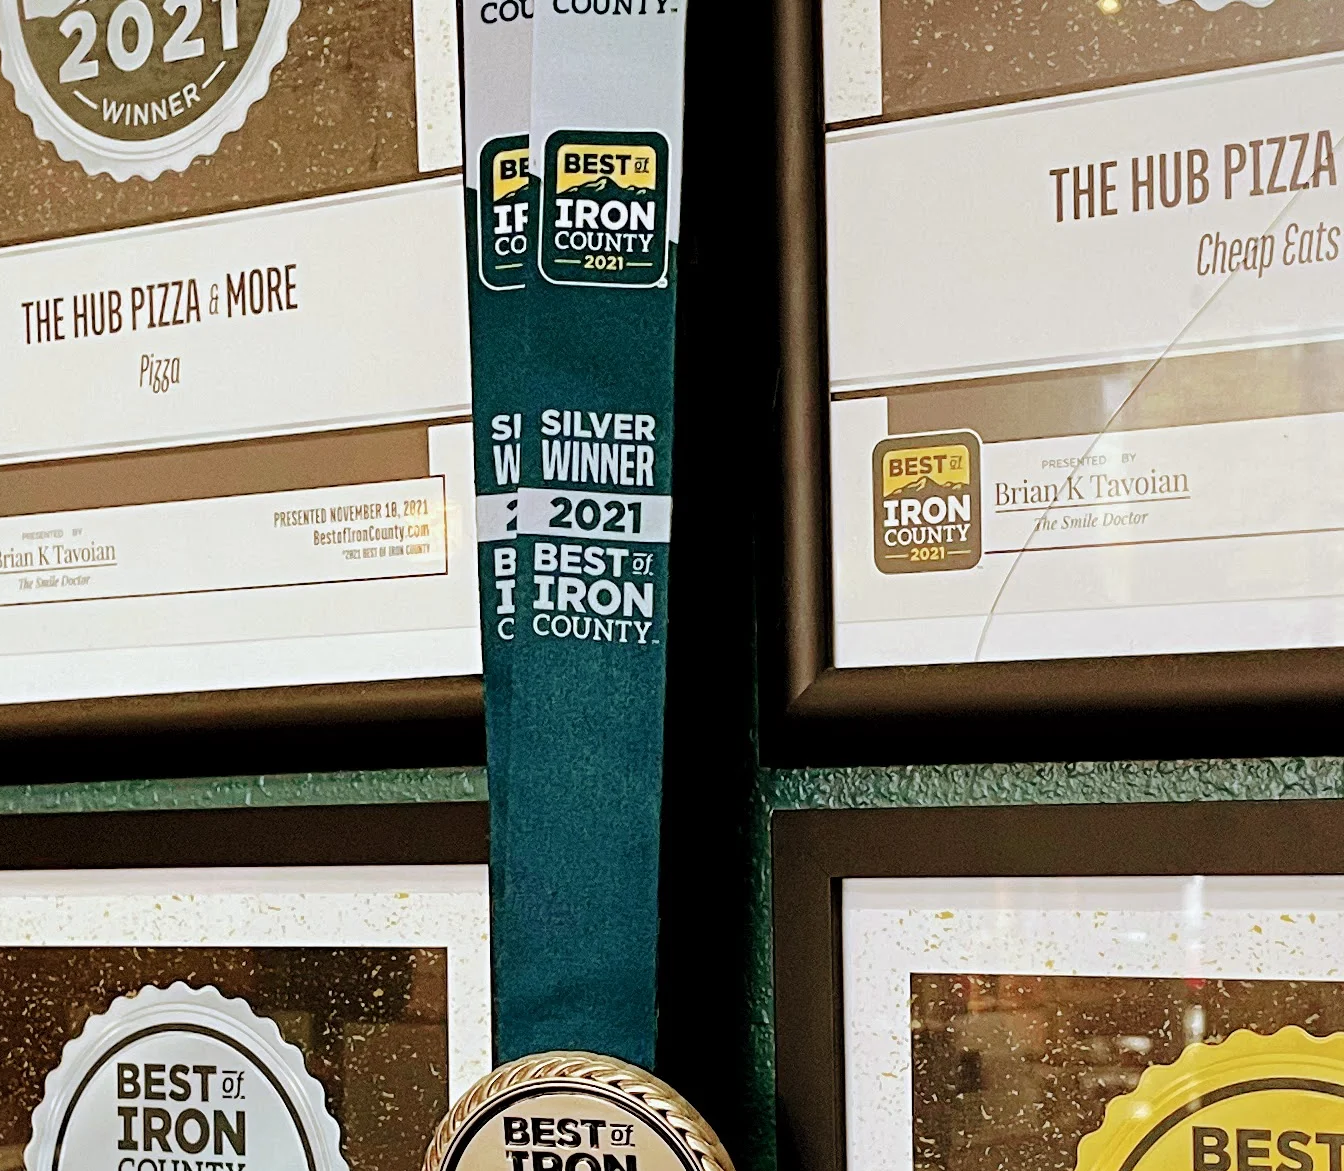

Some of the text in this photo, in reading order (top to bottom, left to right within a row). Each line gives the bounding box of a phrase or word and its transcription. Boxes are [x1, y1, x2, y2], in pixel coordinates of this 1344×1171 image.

[102, 84, 201, 127] WINNER
[1050, 161, 1117, 222] THE
[1132, 149, 1209, 210] HUB
[1225, 130, 1337, 199] PIZZA
[555, 231, 653, 252] COUNTY
[1196, 223, 1341, 278] Cheap Eats
[584, 255, 624, 270] 2021
[21, 297, 66, 345] THE
[72, 289, 123, 338] HUB
[130, 279, 201, 331] PIZZA
[226, 264, 298, 318] MORE
[541, 409, 655, 441] SILVER
[542, 440, 654, 486] WINNER
[1042, 453, 1136, 469] PRESENTED BY
[996, 470, 1190, 506] Brian K Tavoian
[549, 497, 641, 533] 2021
[1034, 510, 1149, 532] The Smile Doctor
[885, 525, 971, 546] COUNTY
[38, 545, 50, 565] K
[53, 541, 116, 563] Tavoian
[534, 543, 653, 577] BEST of
[910, 547, 945, 561] 2021
[533, 575, 654, 617] IRON
[117, 1063, 245, 1101] BEST of
[504, 1117, 635, 1148] BEST of
